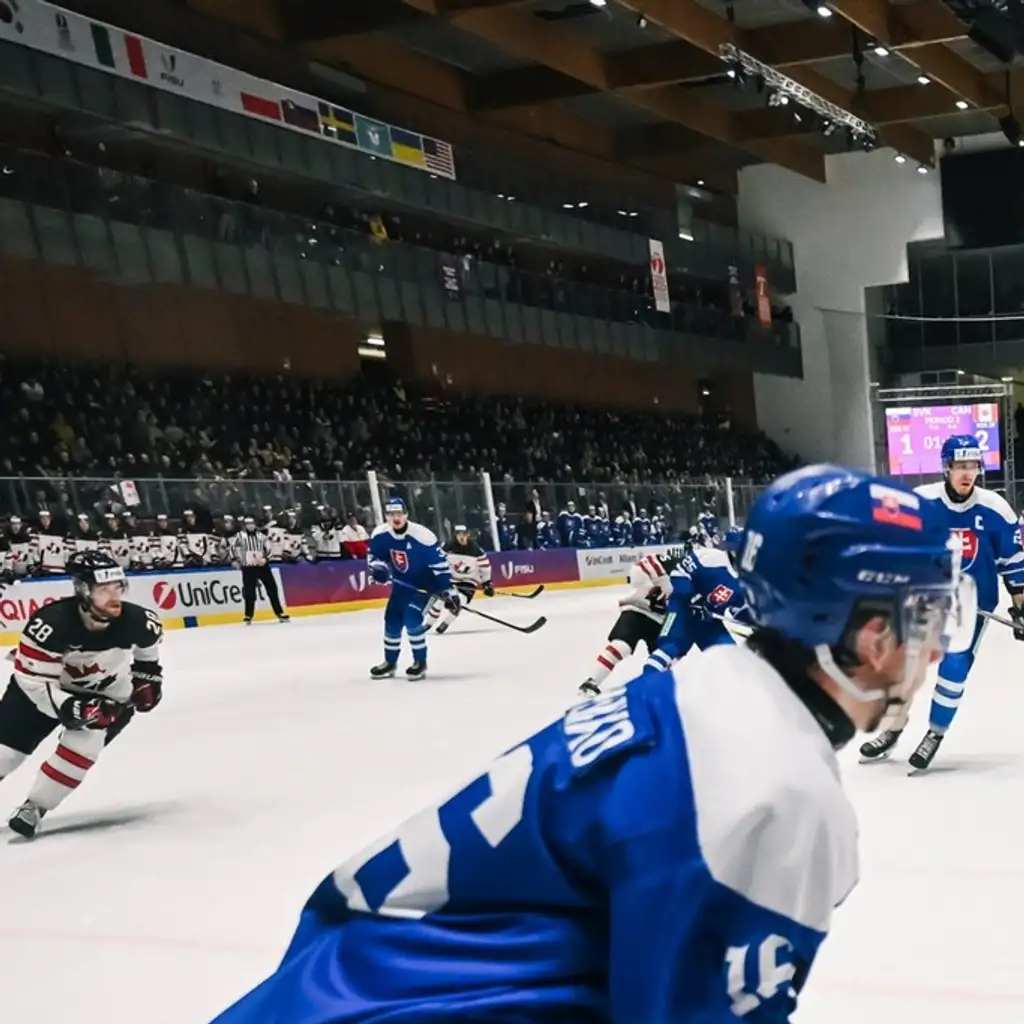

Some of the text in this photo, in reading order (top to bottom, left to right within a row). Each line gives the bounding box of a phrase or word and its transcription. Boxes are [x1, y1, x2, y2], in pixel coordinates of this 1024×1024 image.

[900, 433, 914, 455] 1
[975, 430, 989, 450] 2
[975, 515, 984, 530] C
[857, 569, 910, 584] CCM
[178, 579, 265, 608] UniCret
[28, 618, 54, 643] 28
